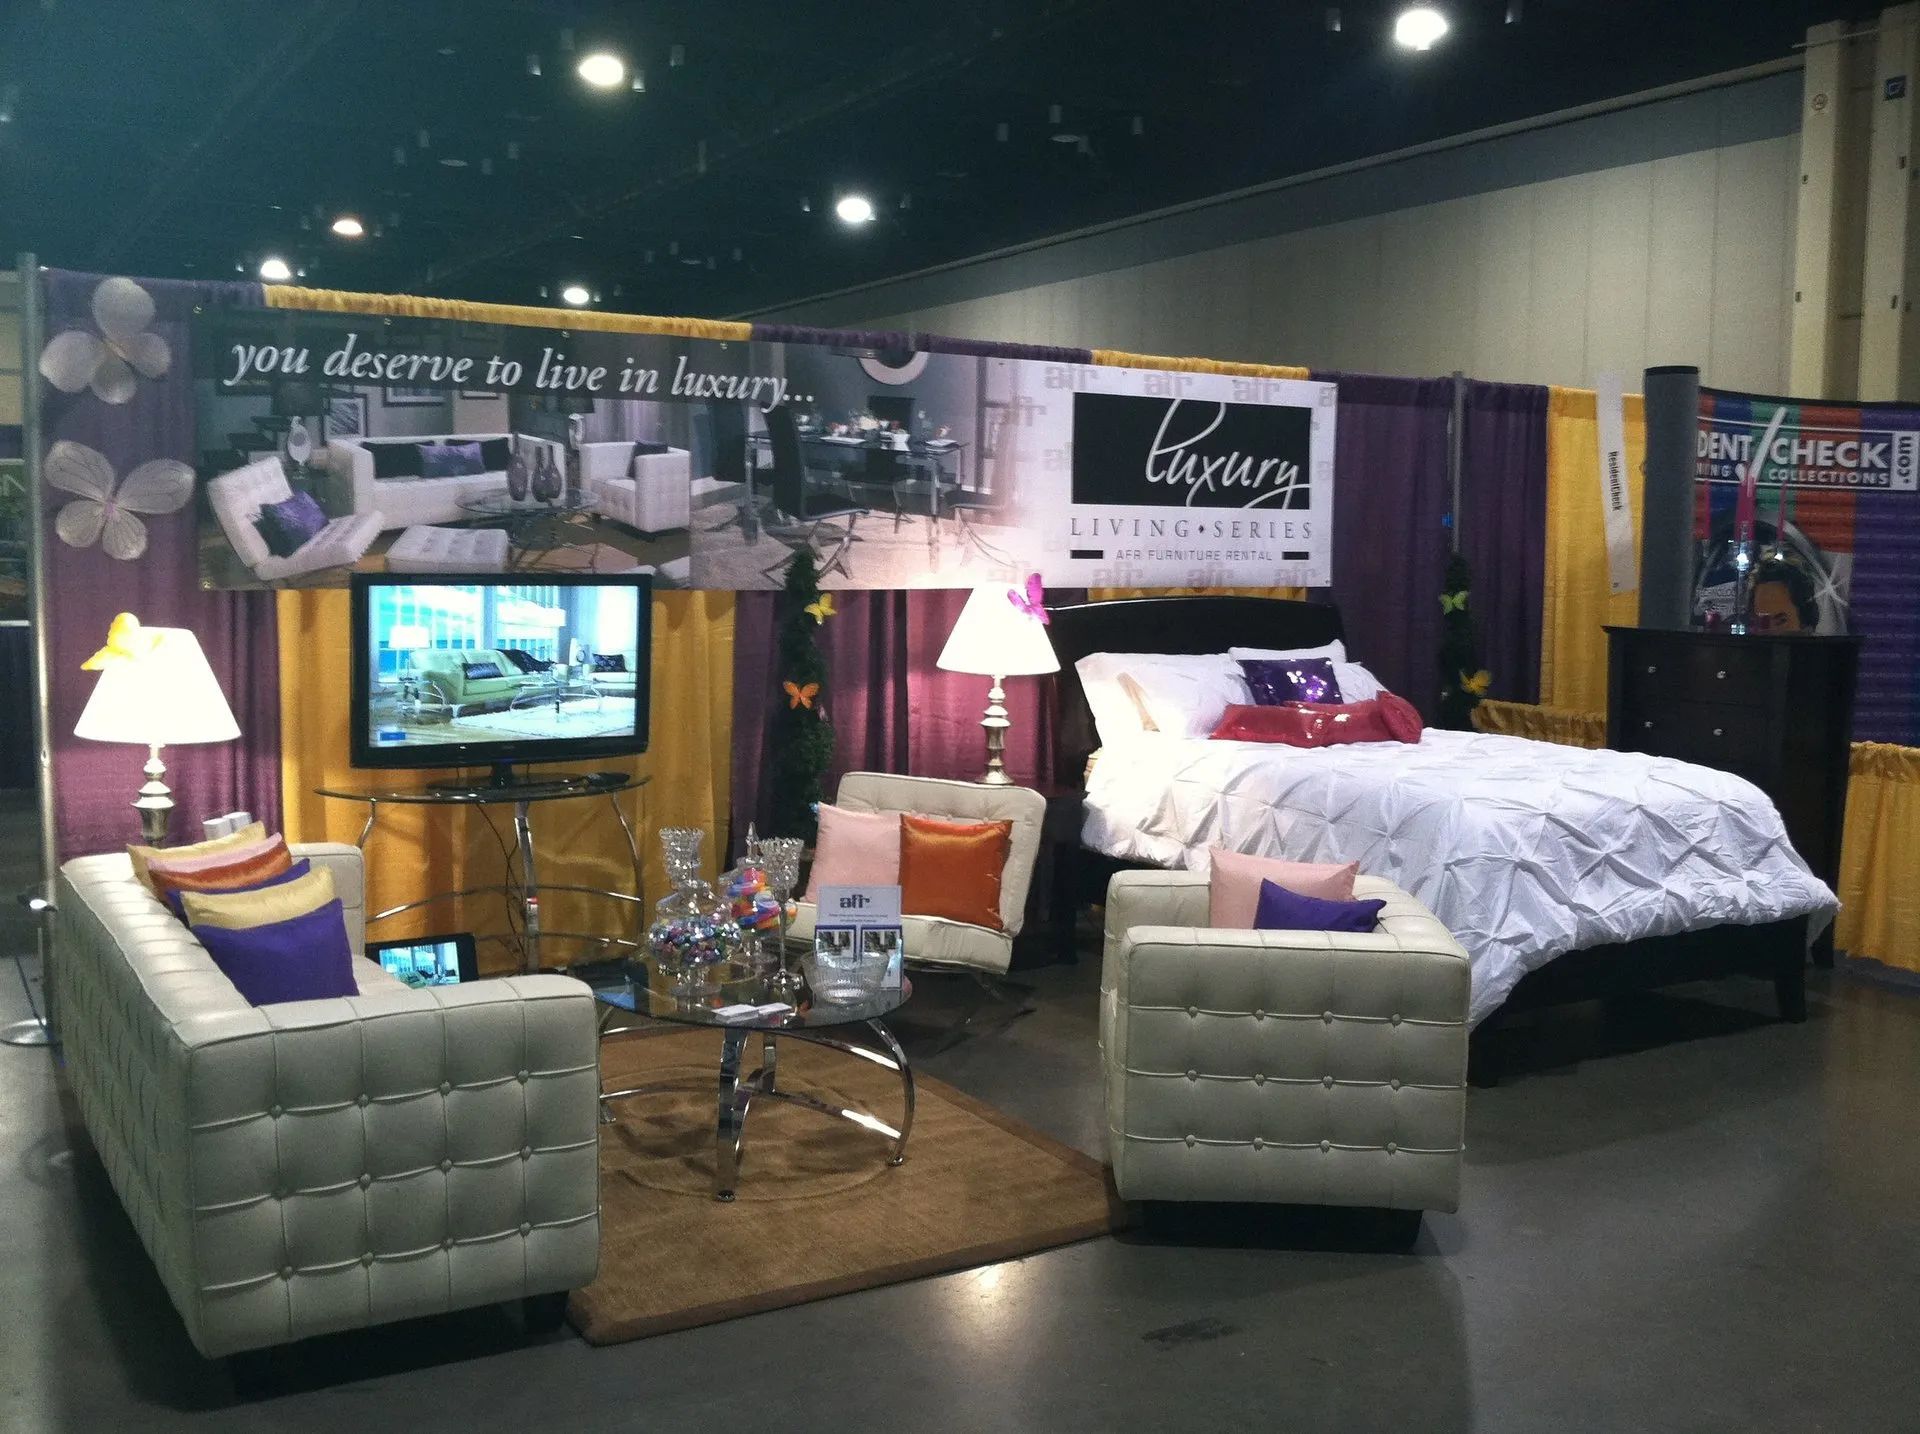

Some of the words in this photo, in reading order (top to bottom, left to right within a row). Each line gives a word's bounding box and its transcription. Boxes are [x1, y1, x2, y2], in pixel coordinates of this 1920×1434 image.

[223, 341, 310, 386] you
[322, 334, 474, 383] deserve
[486, 356, 523, 387] to
[536, 348, 604, 392] live
[620, 356, 658, 394] in
[1769, 438, 1891, 468] CHECK
[1768, 468, 1890, 485] COLLECTIONS
[1071, 517, 1189, 538] LIVING
[1213, 521, 1312, 539] SERIES
[1115, 549, 1141, 560] AFR
[1148, 550, 1221, 561] FURNITURE
[1225, 551, 1273, 561] RENTAL
